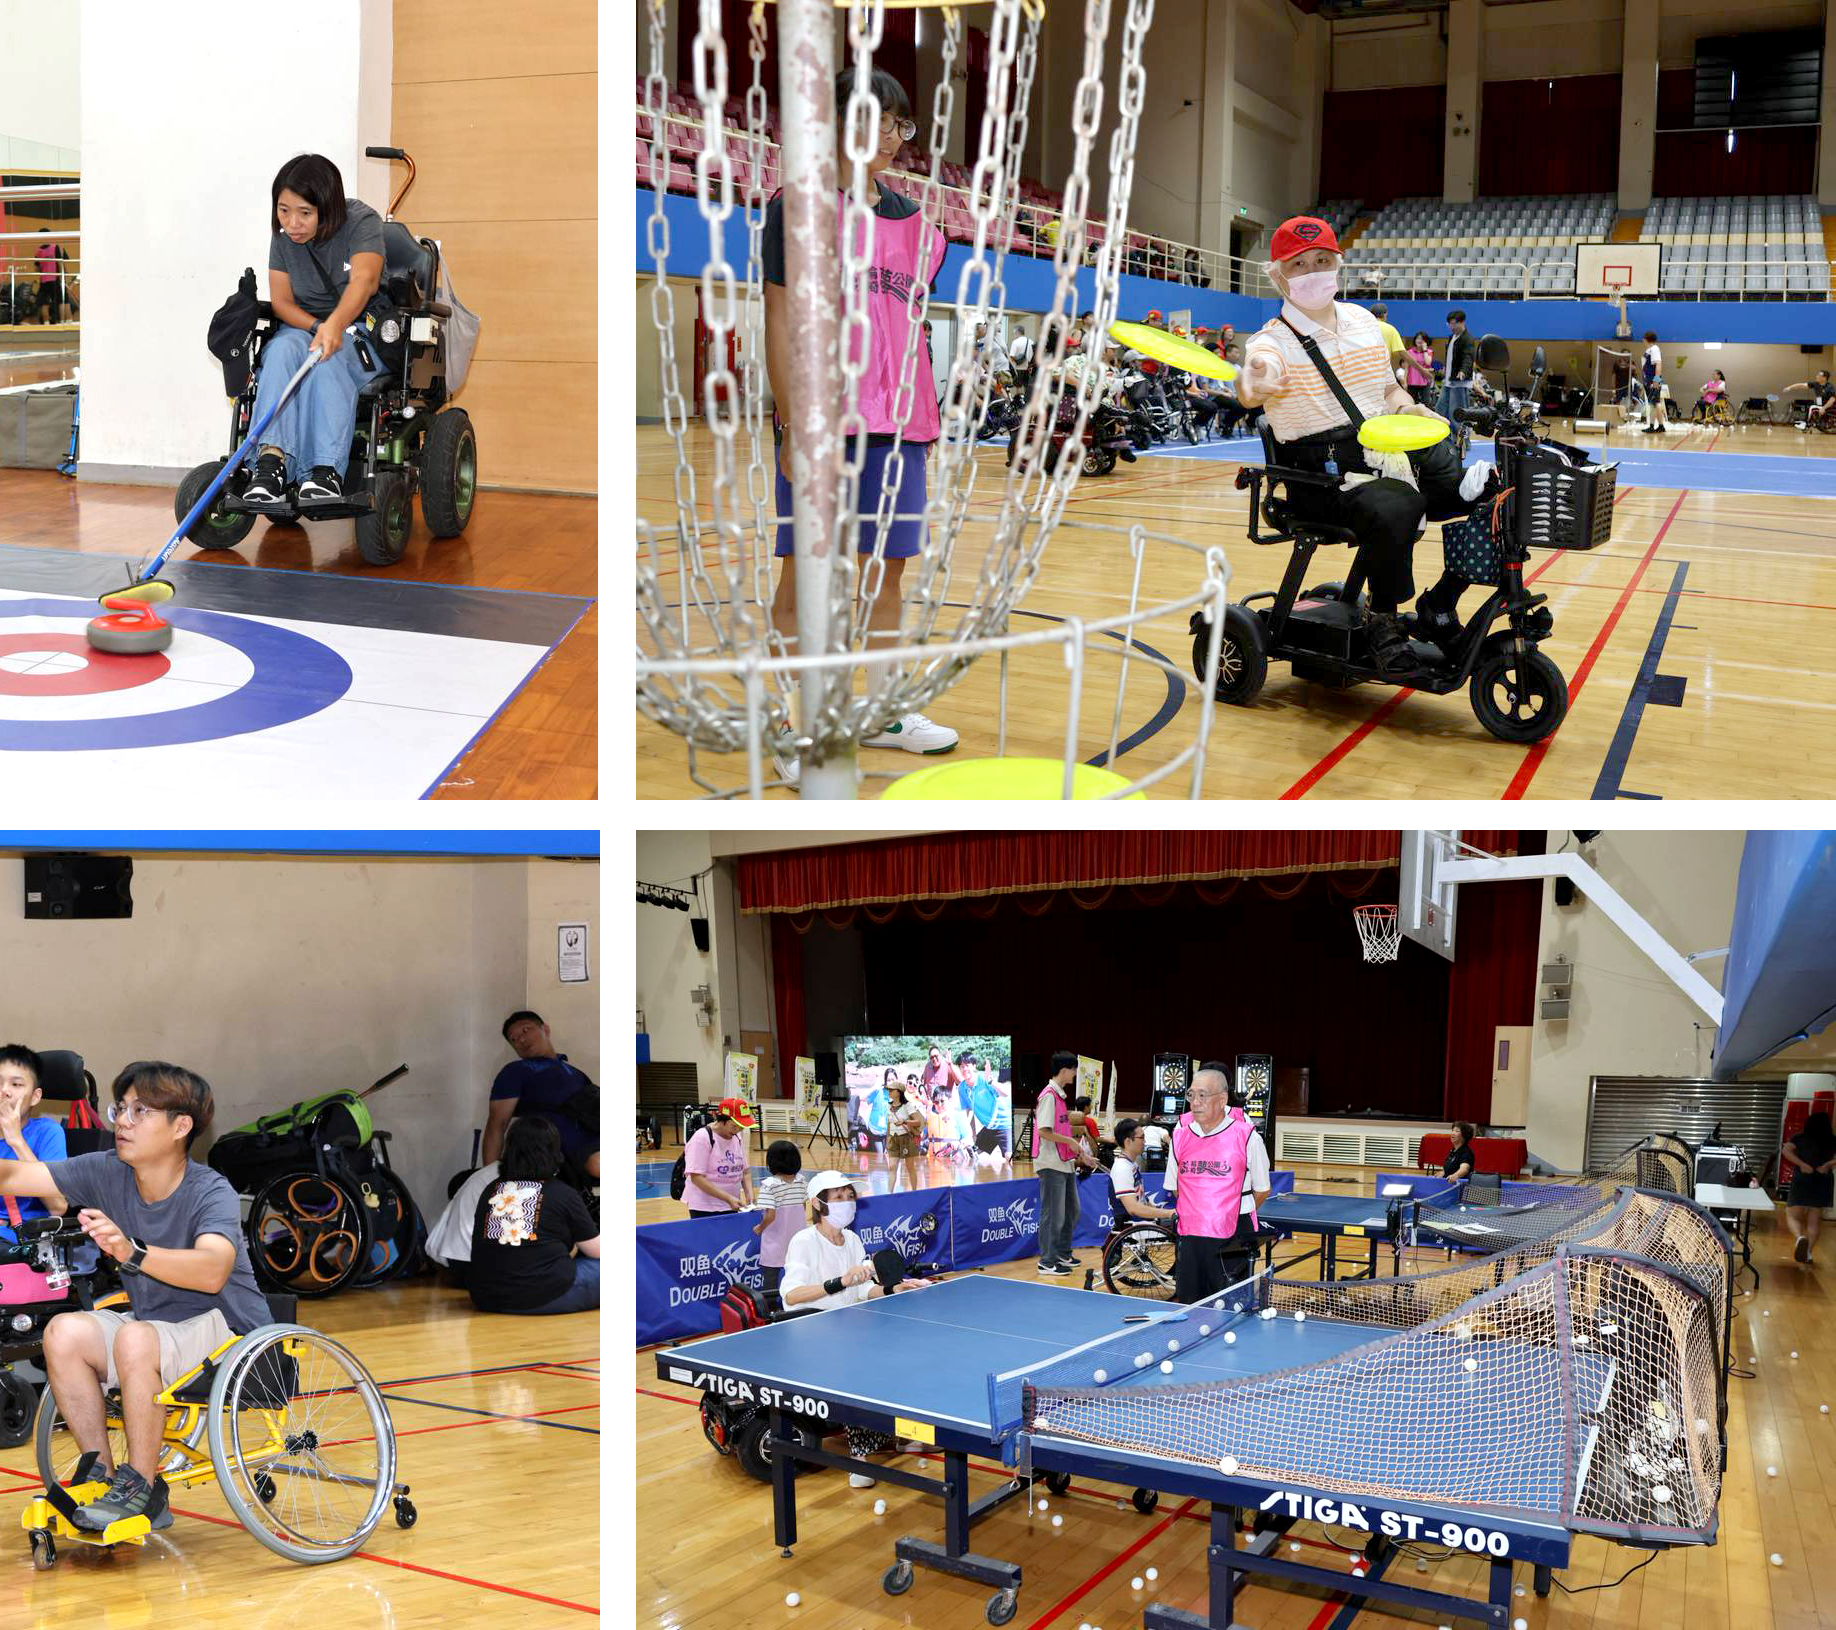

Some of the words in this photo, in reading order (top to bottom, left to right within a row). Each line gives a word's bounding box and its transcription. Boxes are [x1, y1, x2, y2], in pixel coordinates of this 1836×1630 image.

[981, 1226, 1014, 1244] DOUBLE
[669, 1281, 727, 1308] DOUBLE
[693, 1372, 754, 1402] STIGA
[760, 1386, 829, 1419] ST-900
[1260, 1490, 1370, 1531] STIGA
[1380, 1510, 1510, 1557] ST-900
